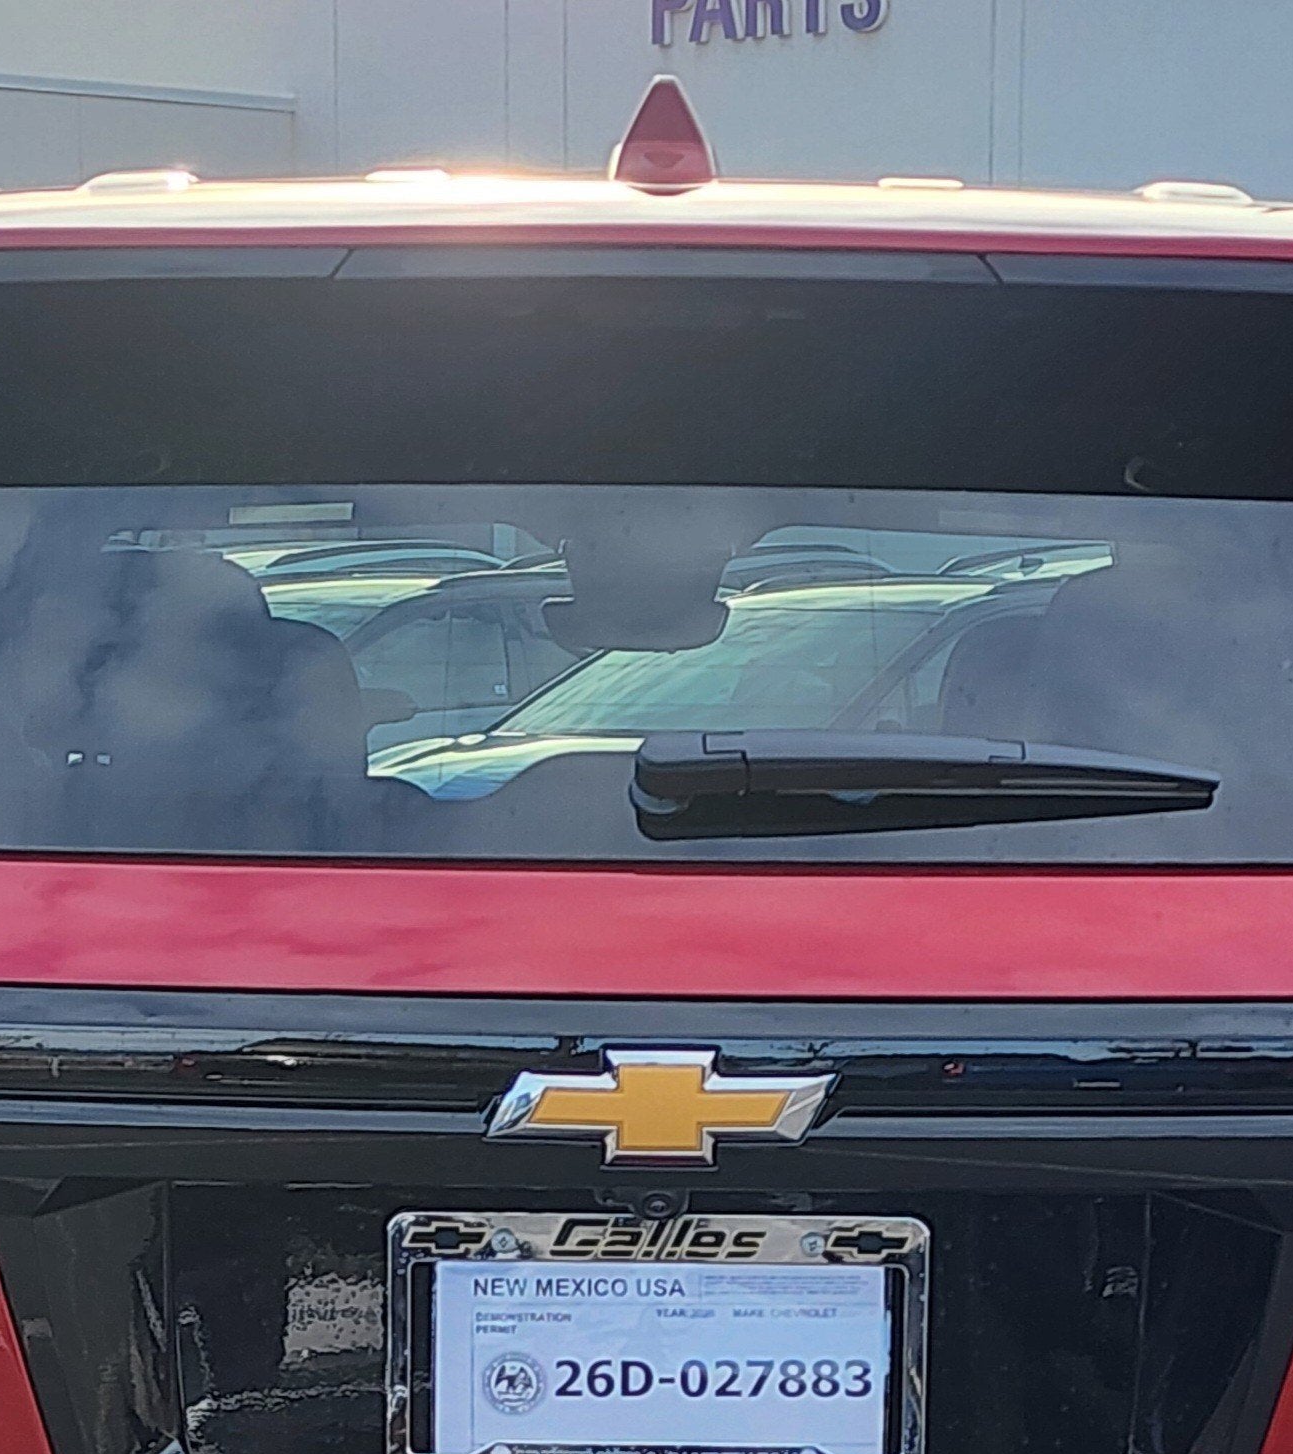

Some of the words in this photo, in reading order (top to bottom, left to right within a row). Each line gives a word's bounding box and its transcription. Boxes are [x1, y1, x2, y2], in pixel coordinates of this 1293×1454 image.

[549, 1217, 767, 1260] Galles
[473, 1278, 527, 1297] NEW
[535, 1277, 628, 1297] MEXICO
[636, 1278, 686, 1297] USA
[554, 1359, 873, 1398] 26D-027883
